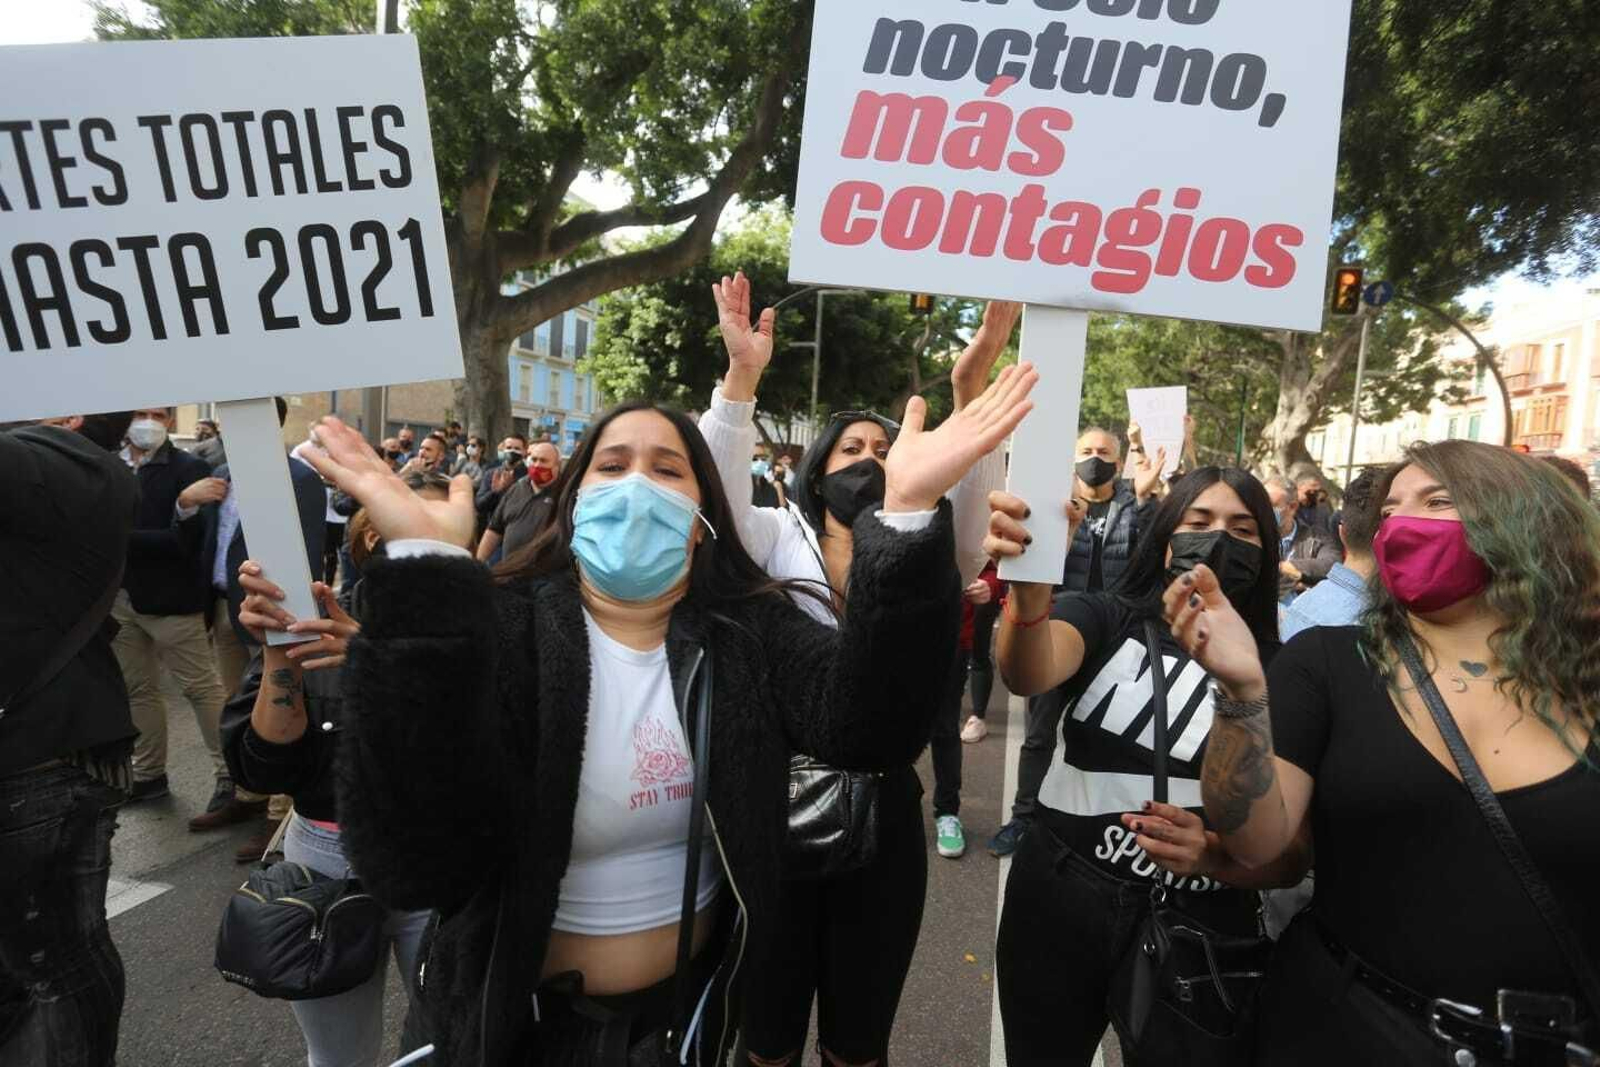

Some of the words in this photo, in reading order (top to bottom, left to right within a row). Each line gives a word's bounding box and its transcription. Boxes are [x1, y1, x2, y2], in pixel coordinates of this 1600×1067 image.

[841, 75, 1072, 176] más
[862, 17, 1287, 128] nocturno,
[137, 104, 413, 203] TOTALES
[244, 217, 435, 331] 2021
[820, 181, 1304, 294] contagios
[629, 789, 659, 811] STAY
